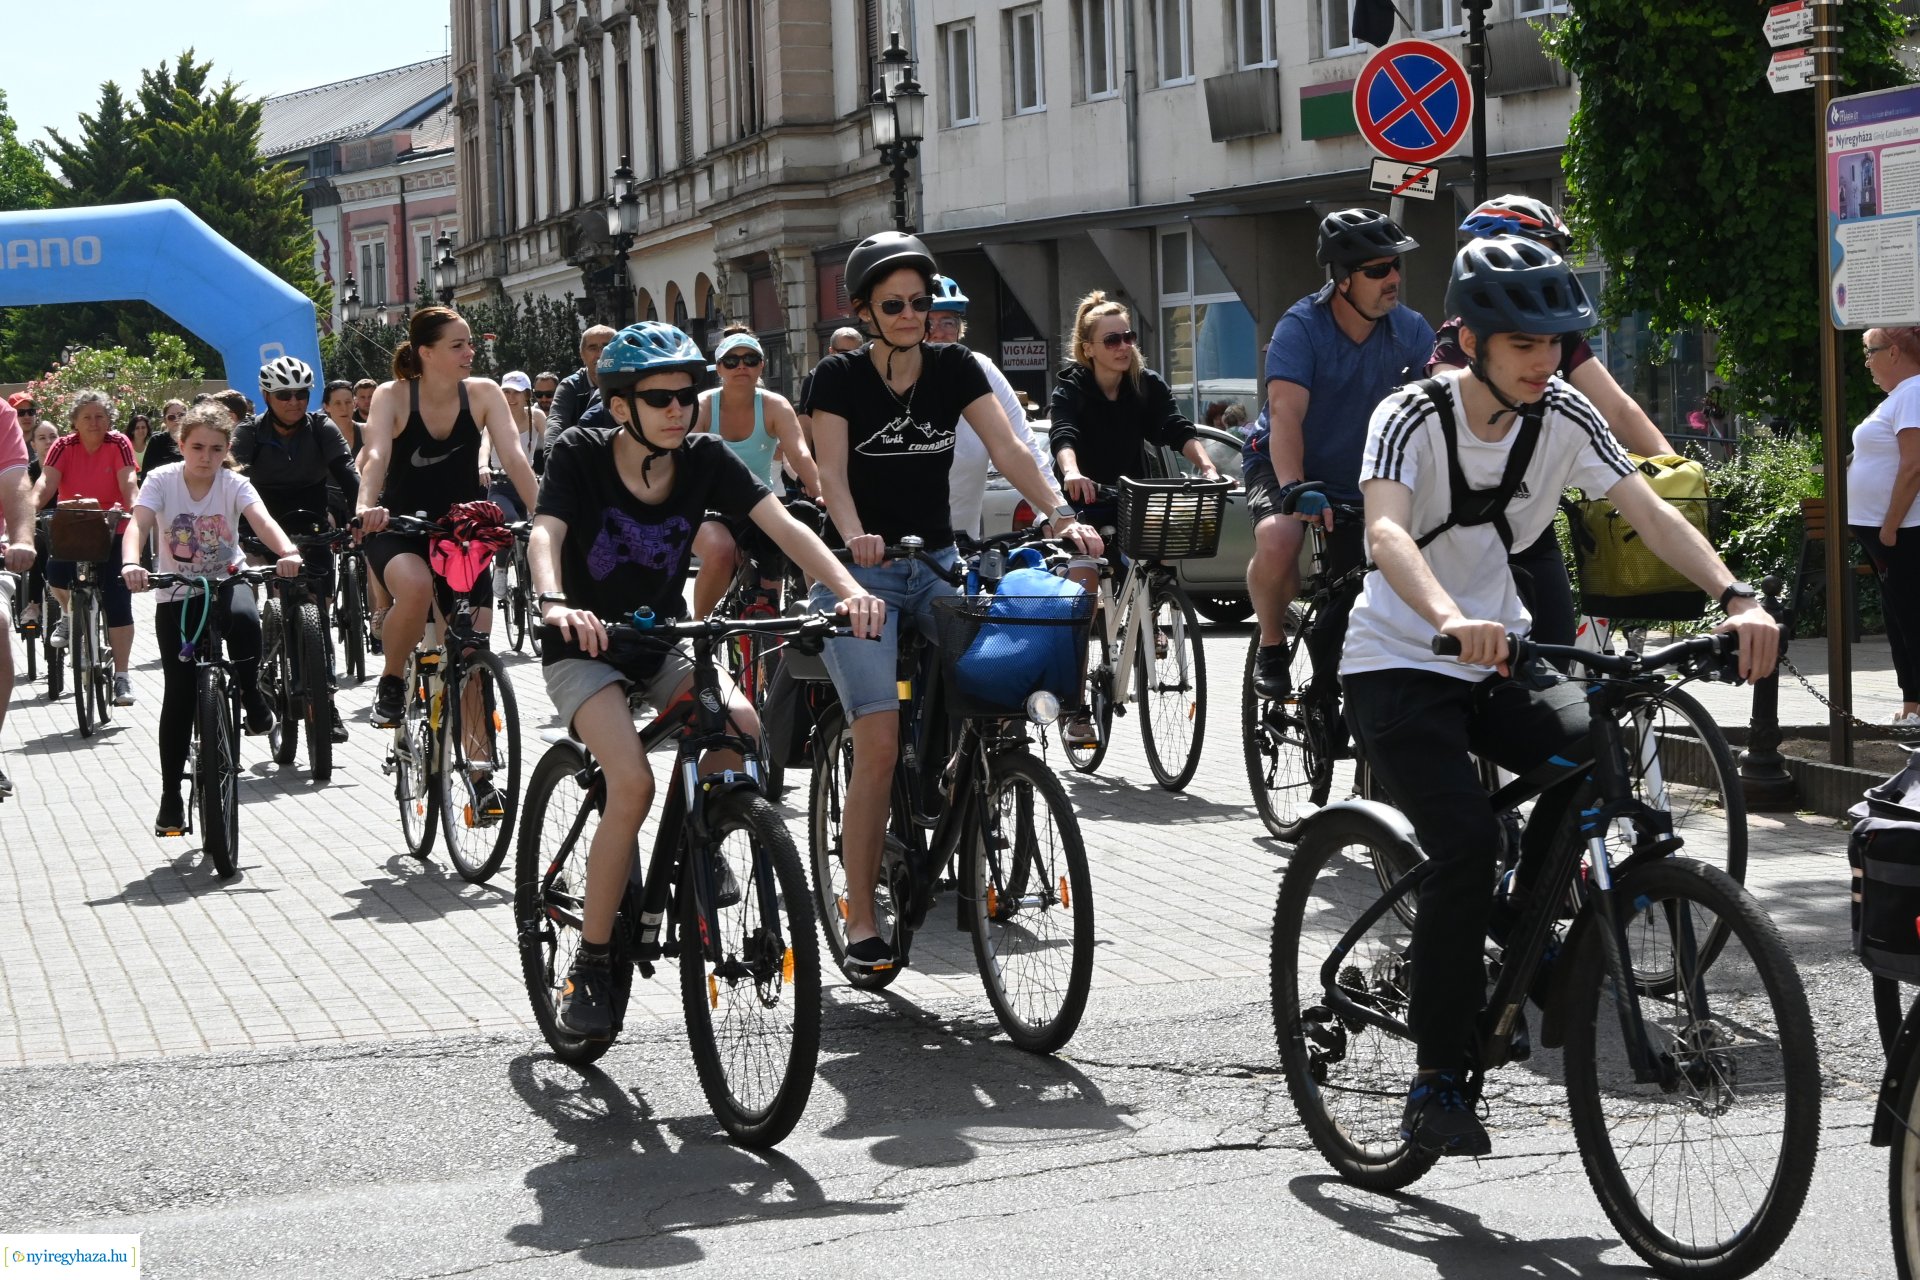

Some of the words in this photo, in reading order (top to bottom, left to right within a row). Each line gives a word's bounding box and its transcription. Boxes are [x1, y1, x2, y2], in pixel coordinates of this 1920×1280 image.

[1836, 130, 1873, 148] Nyíregyháza
[0, 235, 102, 269] ANO
[1003, 344, 1045, 355] VIGYÁZZ
